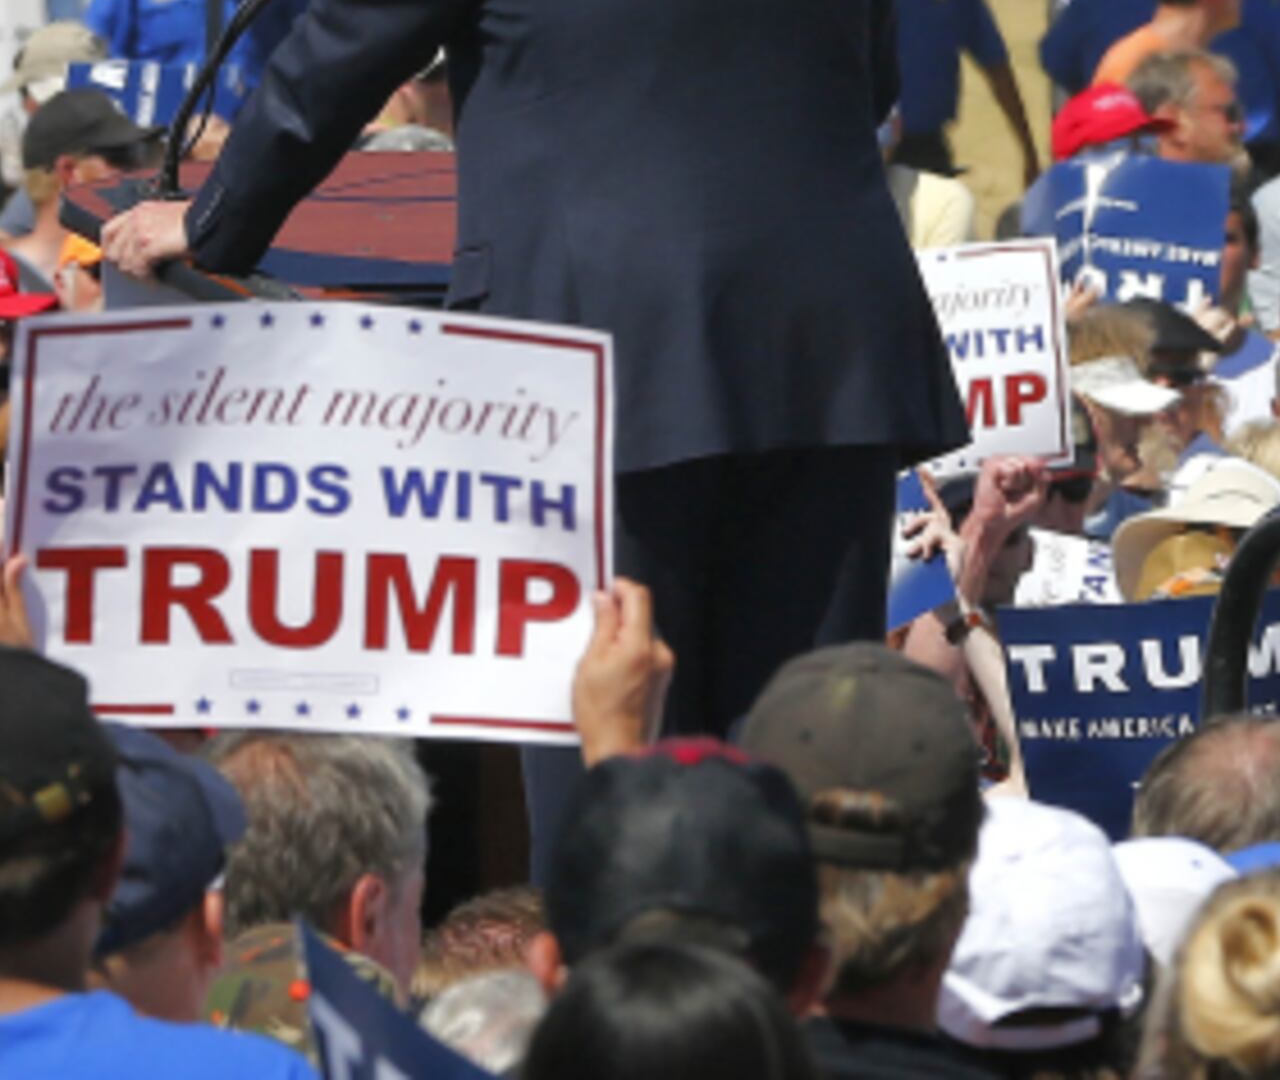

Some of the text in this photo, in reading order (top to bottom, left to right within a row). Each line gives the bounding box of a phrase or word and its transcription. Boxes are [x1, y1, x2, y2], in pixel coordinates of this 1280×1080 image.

[49, 364, 580, 463] the silent majority
[42, 461, 579, 532] STANDS WITH
[36, 545, 584, 659] TRUMP
[1020, 714, 1196, 740] MAKE AMERICA
